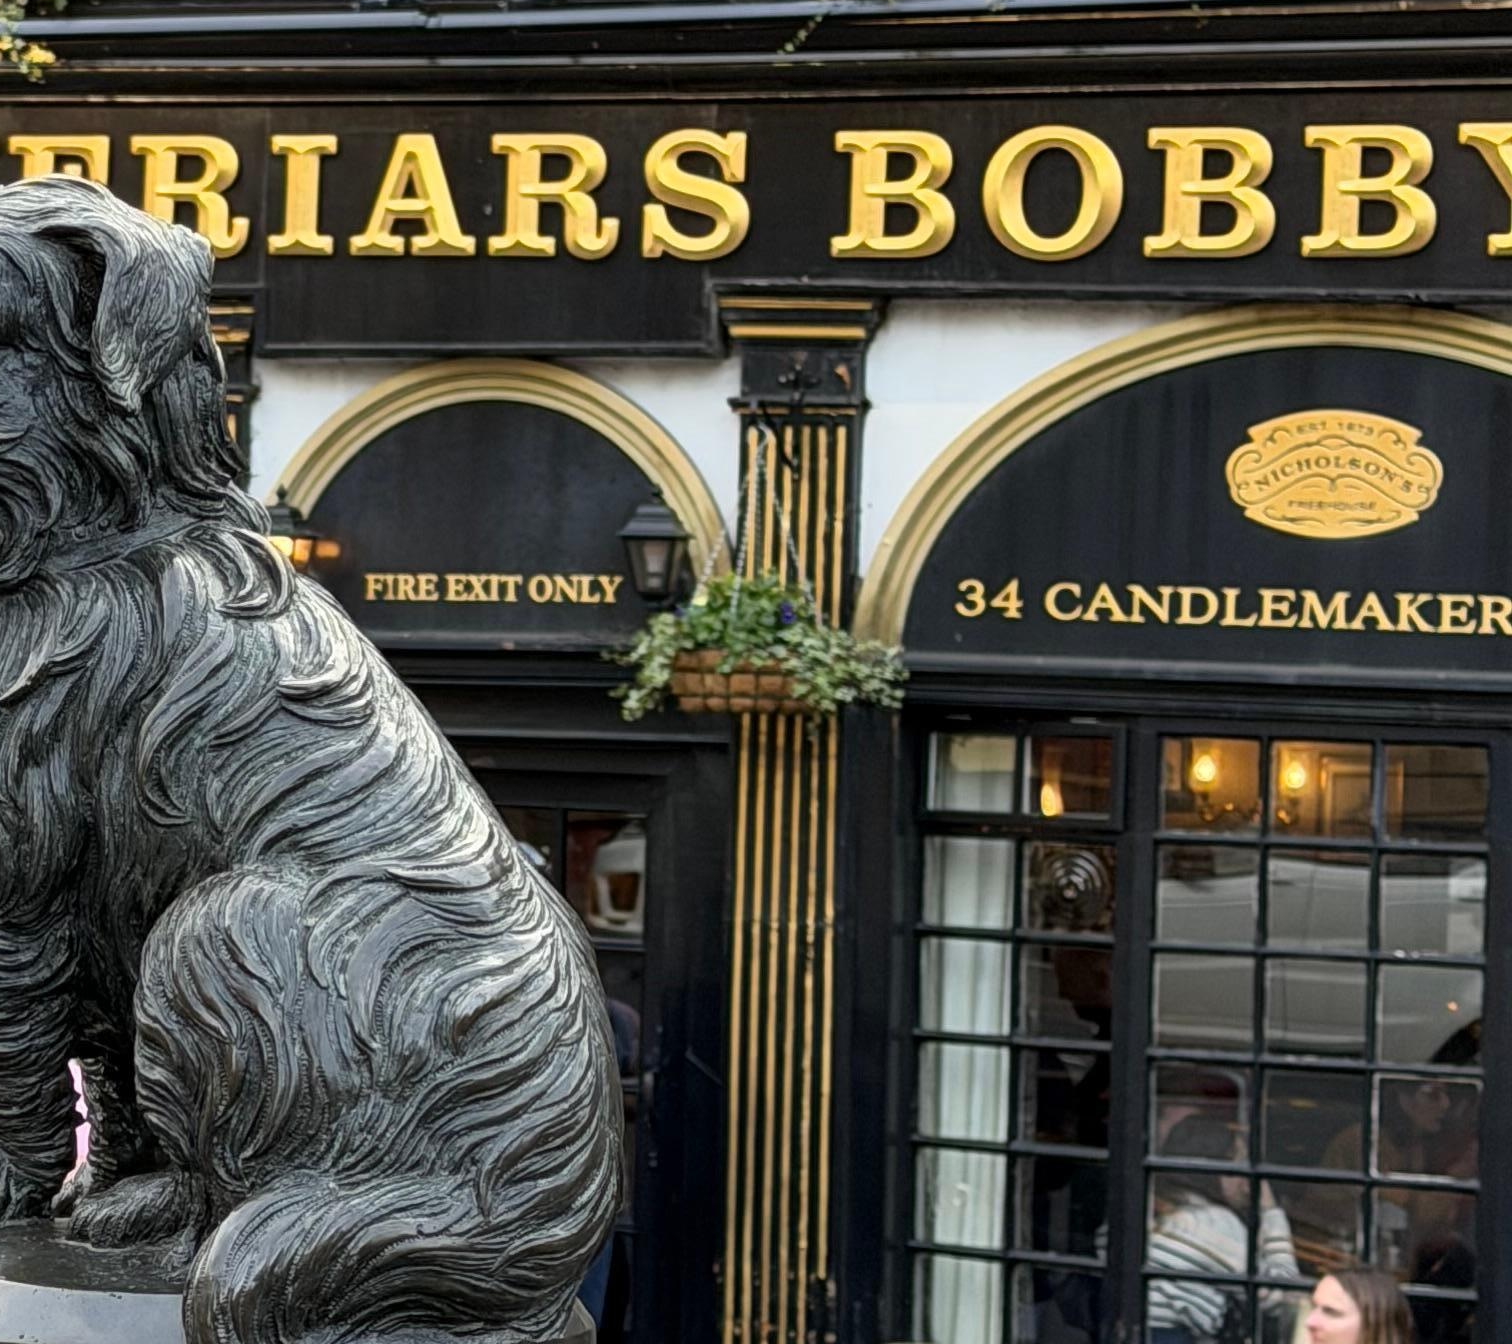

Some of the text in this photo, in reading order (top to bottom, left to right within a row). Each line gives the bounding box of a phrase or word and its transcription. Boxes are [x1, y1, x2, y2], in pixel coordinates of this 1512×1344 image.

[1255, 455, 1414, 493] NICHOLSON'S
[365, 573, 623, 604] FIRE EXIT ONLY
[954, 577, 1512, 636] 34 CANDLEMAKER
